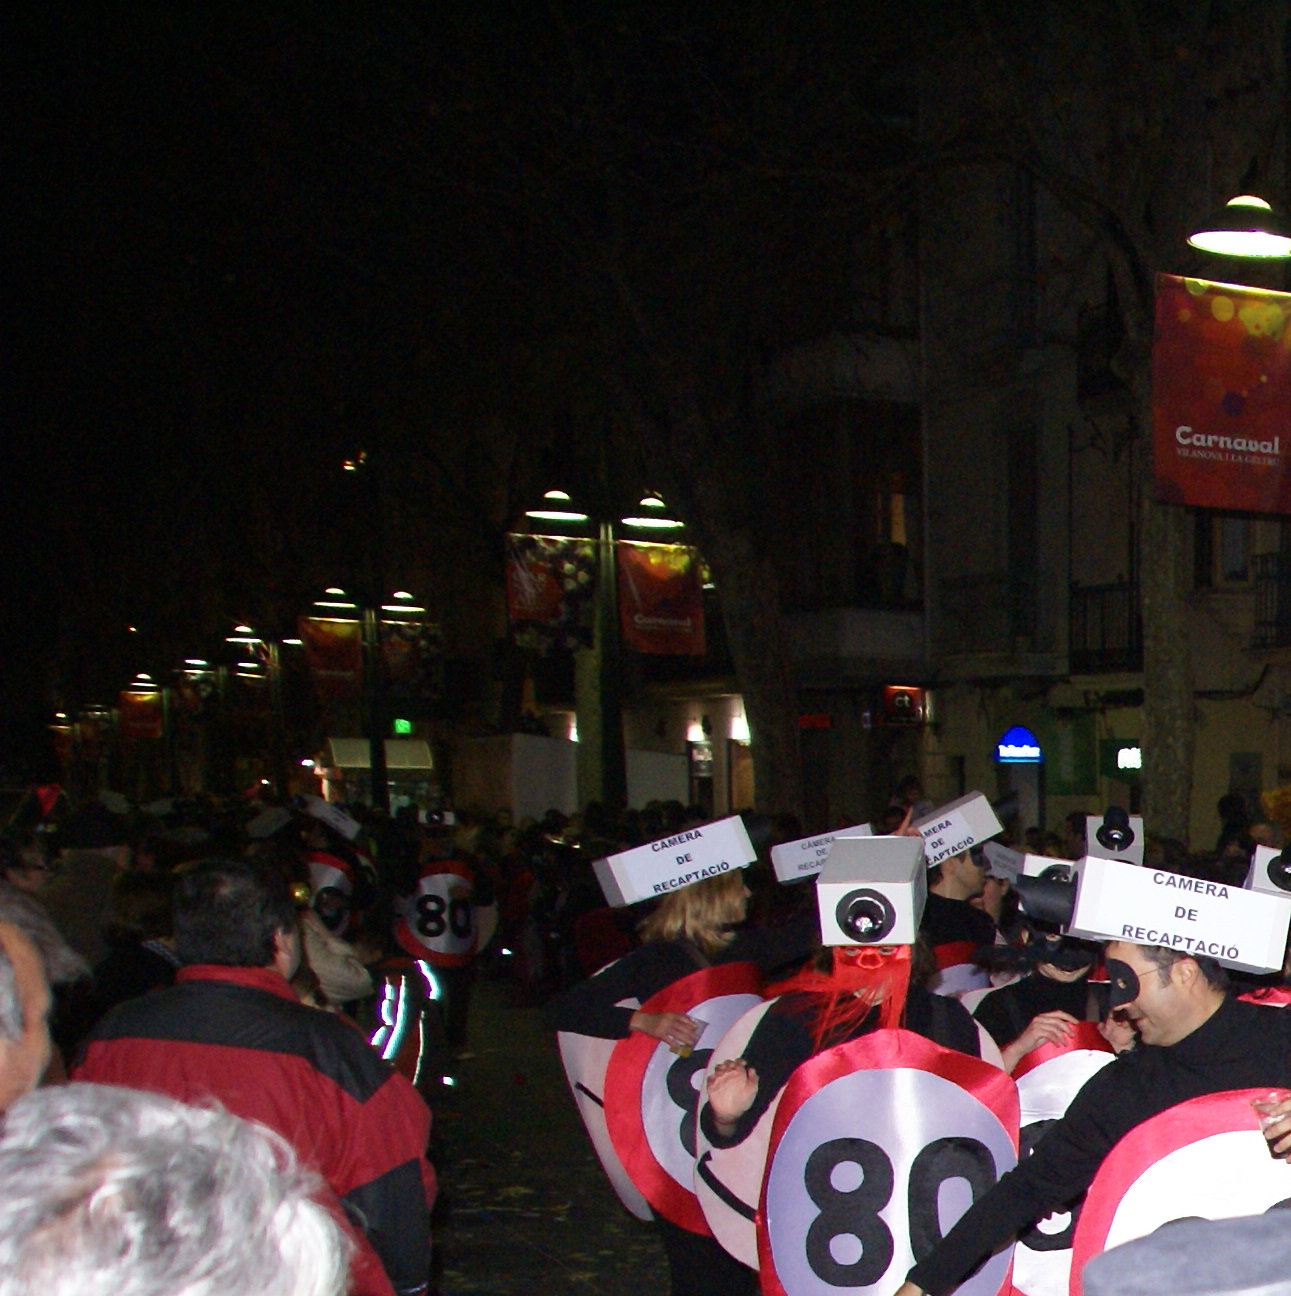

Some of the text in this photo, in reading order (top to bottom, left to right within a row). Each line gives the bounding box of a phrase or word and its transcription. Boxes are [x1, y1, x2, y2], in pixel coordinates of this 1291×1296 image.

[1175, 425, 1280, 455] Carnaval
[923, 819, 953, 838] MERA
[930, 837, 945, 849] DE
[675, 853, 693, 866] DE
[798, 857, 826, 872] RECAP
[416, 894, 471, 940] 80
[1174, 905, 1198, 922] DE
[1122, 924, 1240, 960] RECAPTACIÓ
[804, 1136, 998, 1288] 80
